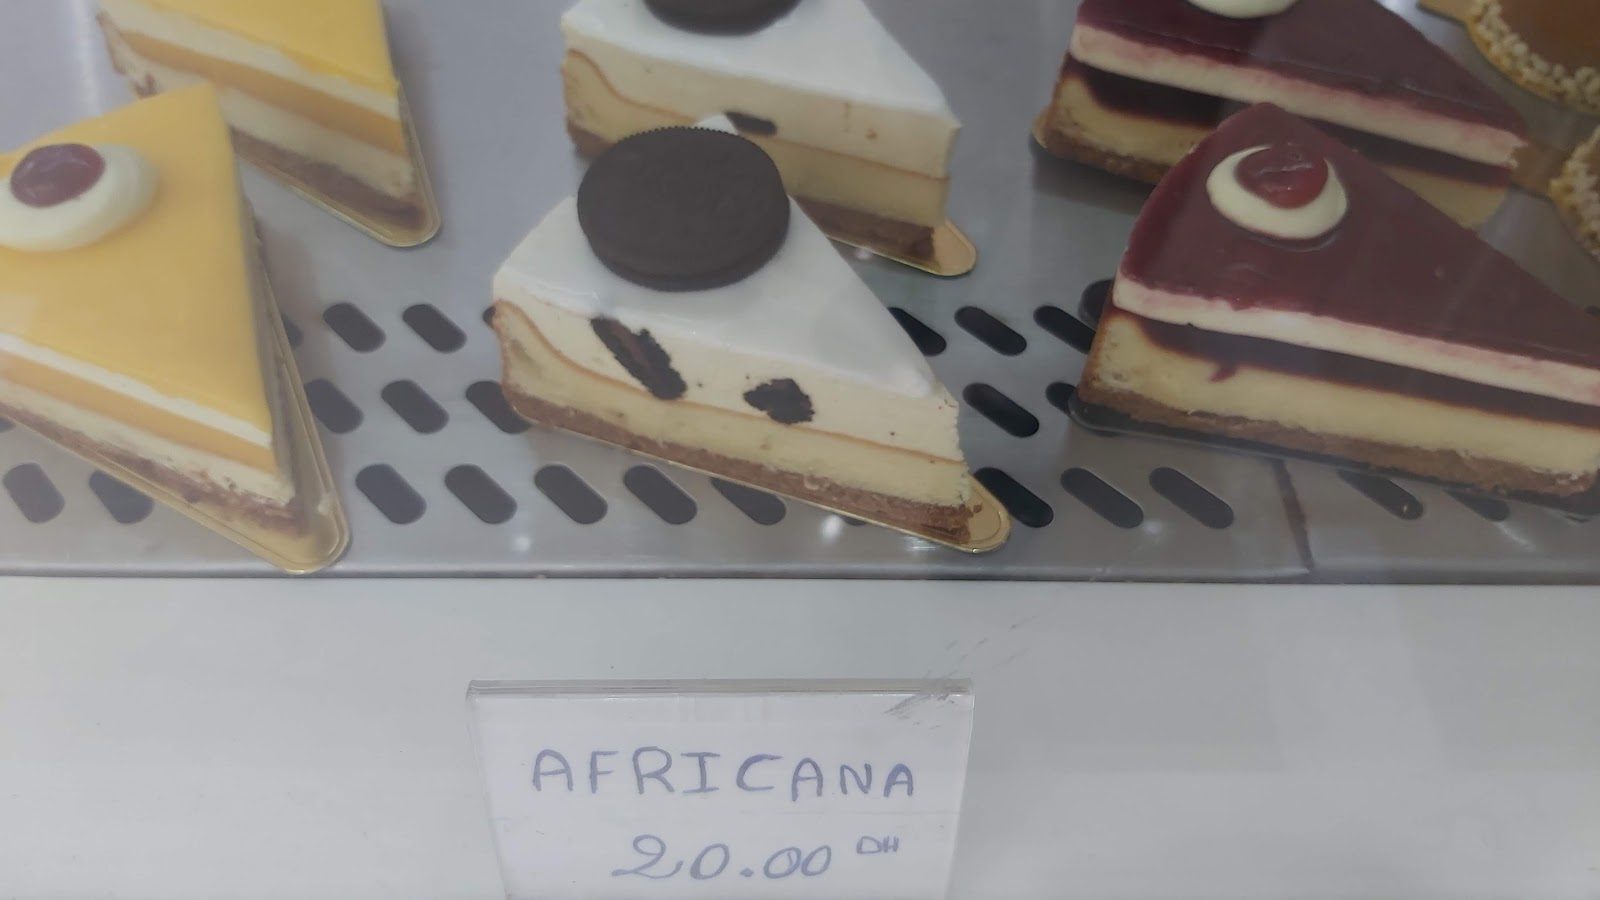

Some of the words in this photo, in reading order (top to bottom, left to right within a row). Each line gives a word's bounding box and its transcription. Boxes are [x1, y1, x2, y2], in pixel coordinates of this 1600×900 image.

[531, 745, 916, 802] AFRICANA
[611, 834, 832, 881] 20.00
[855, 835, 901, 856] DH
